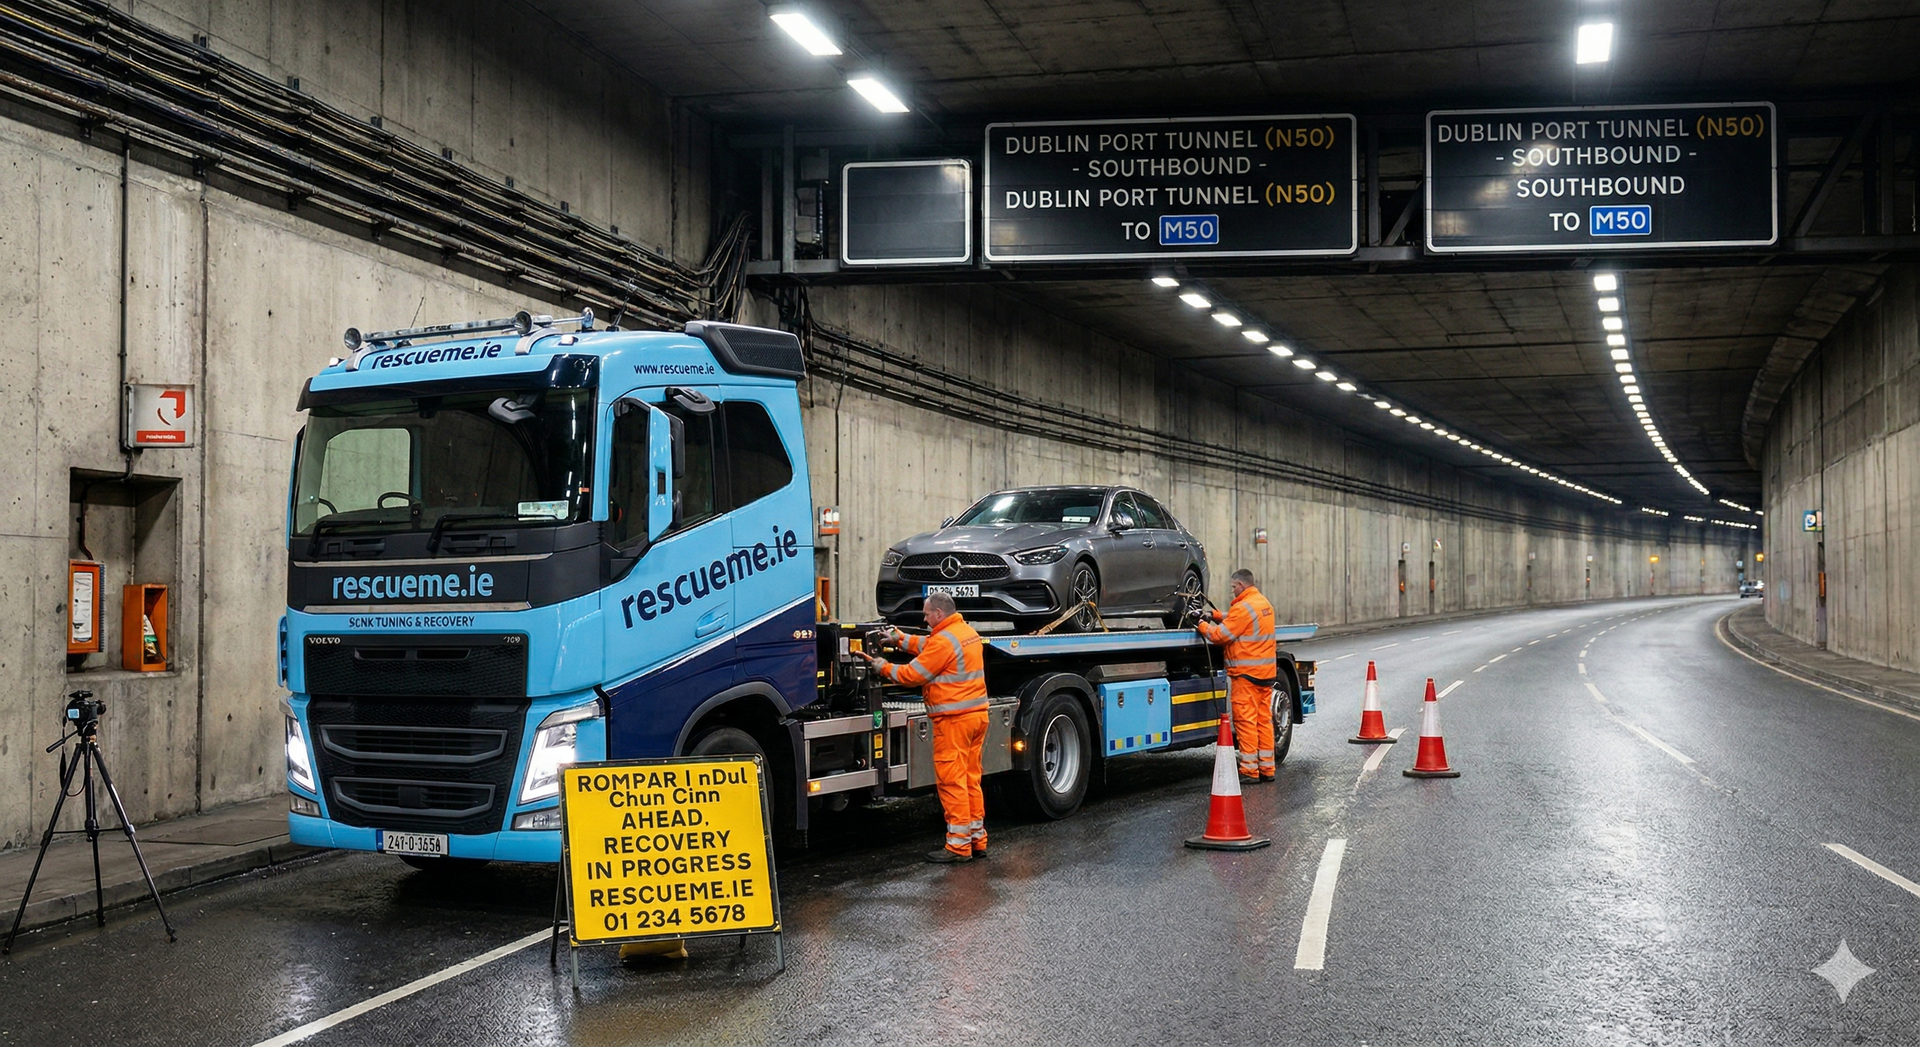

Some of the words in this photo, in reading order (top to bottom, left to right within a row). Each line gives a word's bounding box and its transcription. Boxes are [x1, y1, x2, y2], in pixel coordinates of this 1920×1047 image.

[1005, 134, 1090, 155] DUBLIN
[1099, 131, 1158, 153] PORT
[1164, 128, 1259, 151] TUNNEL
[1265, 125, 1336, 151] (N50)
[1438, 122, 1522, 143] DUBLIN
[1531, 120, 1590, 141] PORT
[1599, 118, 1690, 139] TUNNEL
[1696, 114, 1765, 140] (N50)
[1087, 157, 1251, 178] SOUTHBOUND
[1511, 145, 1682, 167] SOUTHBOUND
[1005, 190, 1090, 210] DUBLIN
[1099, 187, 1159, 208] PORT
[1164, 185, 1260, 207] TUNNEL
[1265, 181, 1336, 207] (N50)
[1516, 176, 1686, 199] SOUTHBOUND
[1121, 221, 1151, 241] TO
[1164, 219, 1215, 240] M50
[1549, 211, 1581, 232] TO
[1595, 210, 1647, 231] M50
[371, 341, 502, 370] rescueme.ie
[633, 362, 716, 375] www.rescueme.ie
[332, 565, 495, 600] rescueme.ie
[620, 525, 798, 630] rescueme.ie
[375, 616, 413, 627] TUNING
[415, 617, 422, 627] &
[423, 615, 475, 627] RECOVERY
[308, 637, 341, 645] VOLVO
[577, 771, 677, 793] ROMPAR
[609, 791, 666, 808] Chun
[672, 787, 721, 805] Cinn
[621, 808, 710, 830] AHEAD,
[603, 829, 731, 855] RECOVERY
[587, 861, 613, 880] IN
[622, 852, 752, 878] PROGRESS
[590, 879, 754, 908] RESCUEME.IE
[603, 911, 629, 932] 01
[636, 907, 682, 929] 234
[690, 903, 746, 926] 5678
